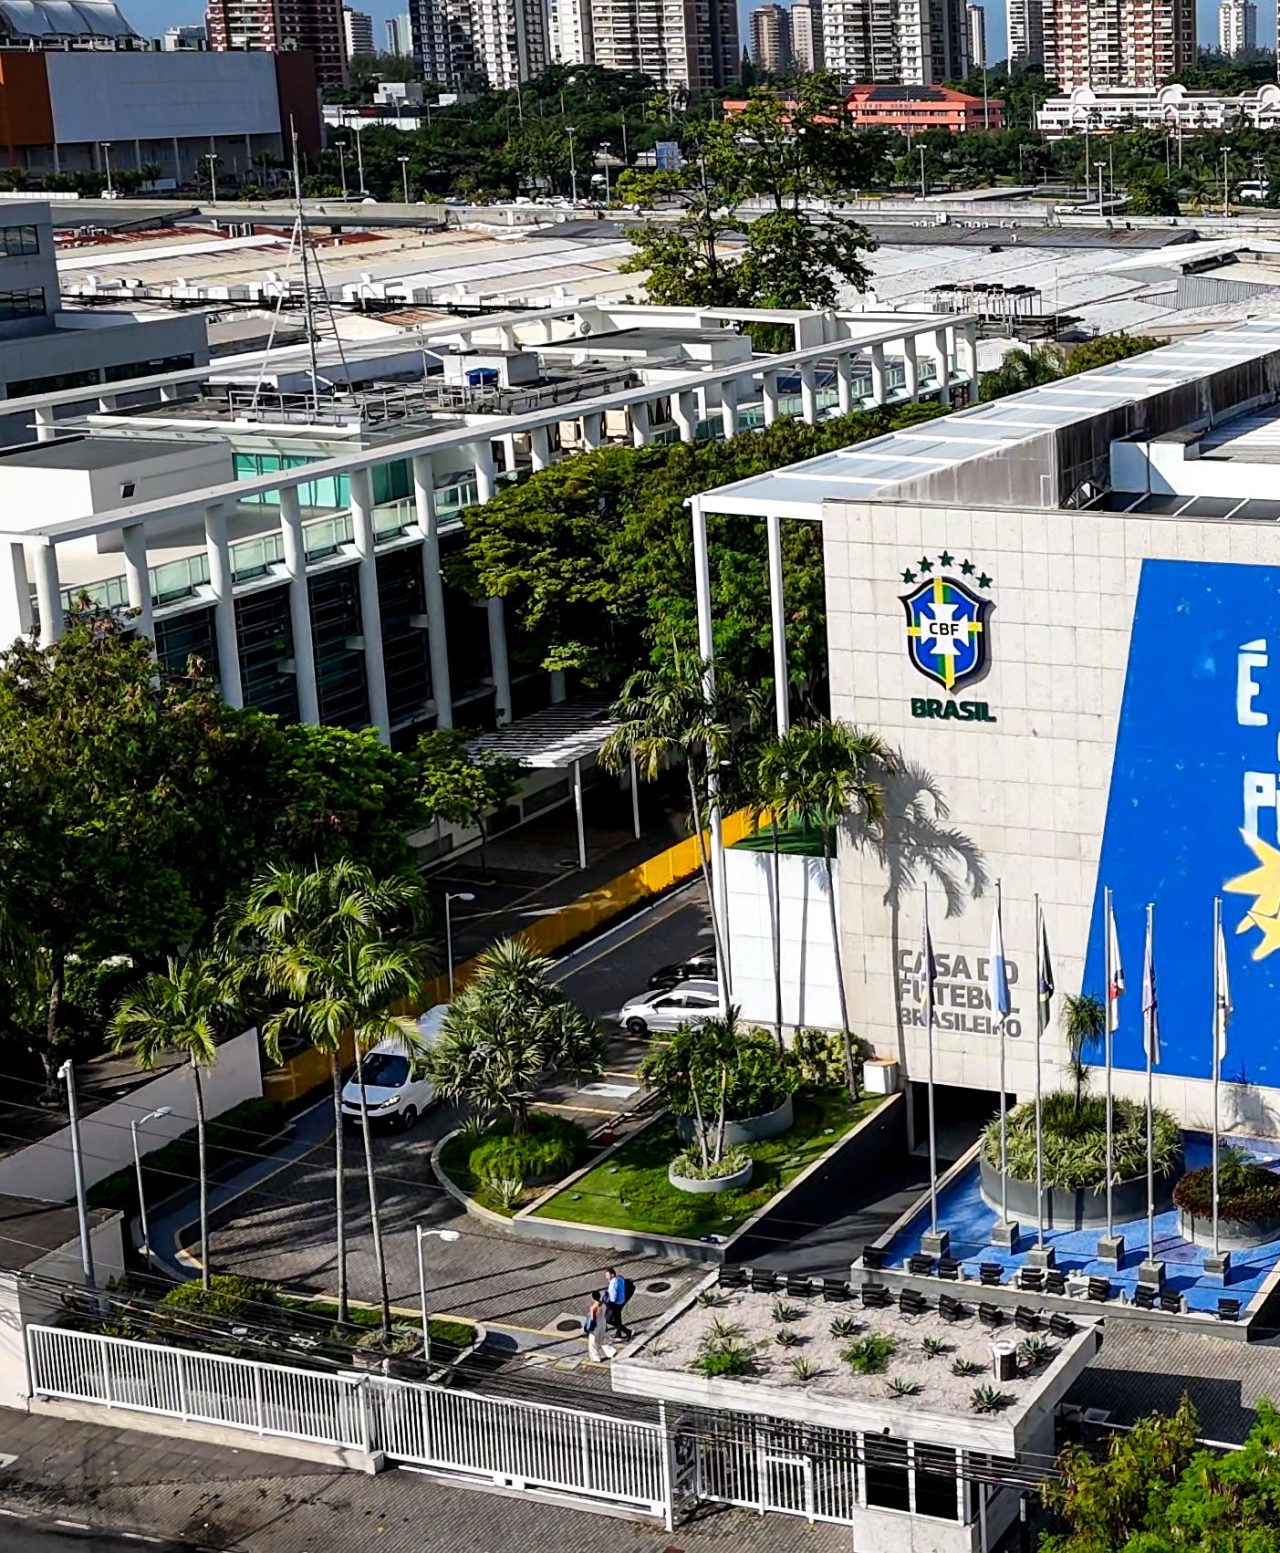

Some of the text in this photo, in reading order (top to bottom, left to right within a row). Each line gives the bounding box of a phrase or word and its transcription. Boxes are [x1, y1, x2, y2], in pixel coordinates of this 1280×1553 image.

[929, 622, 960, 637] CBF
[1237, 638, 1268, 727] É
[911, 697, 997, 722] BRASIL
[899, 978, 1021, 1014] FTEB
